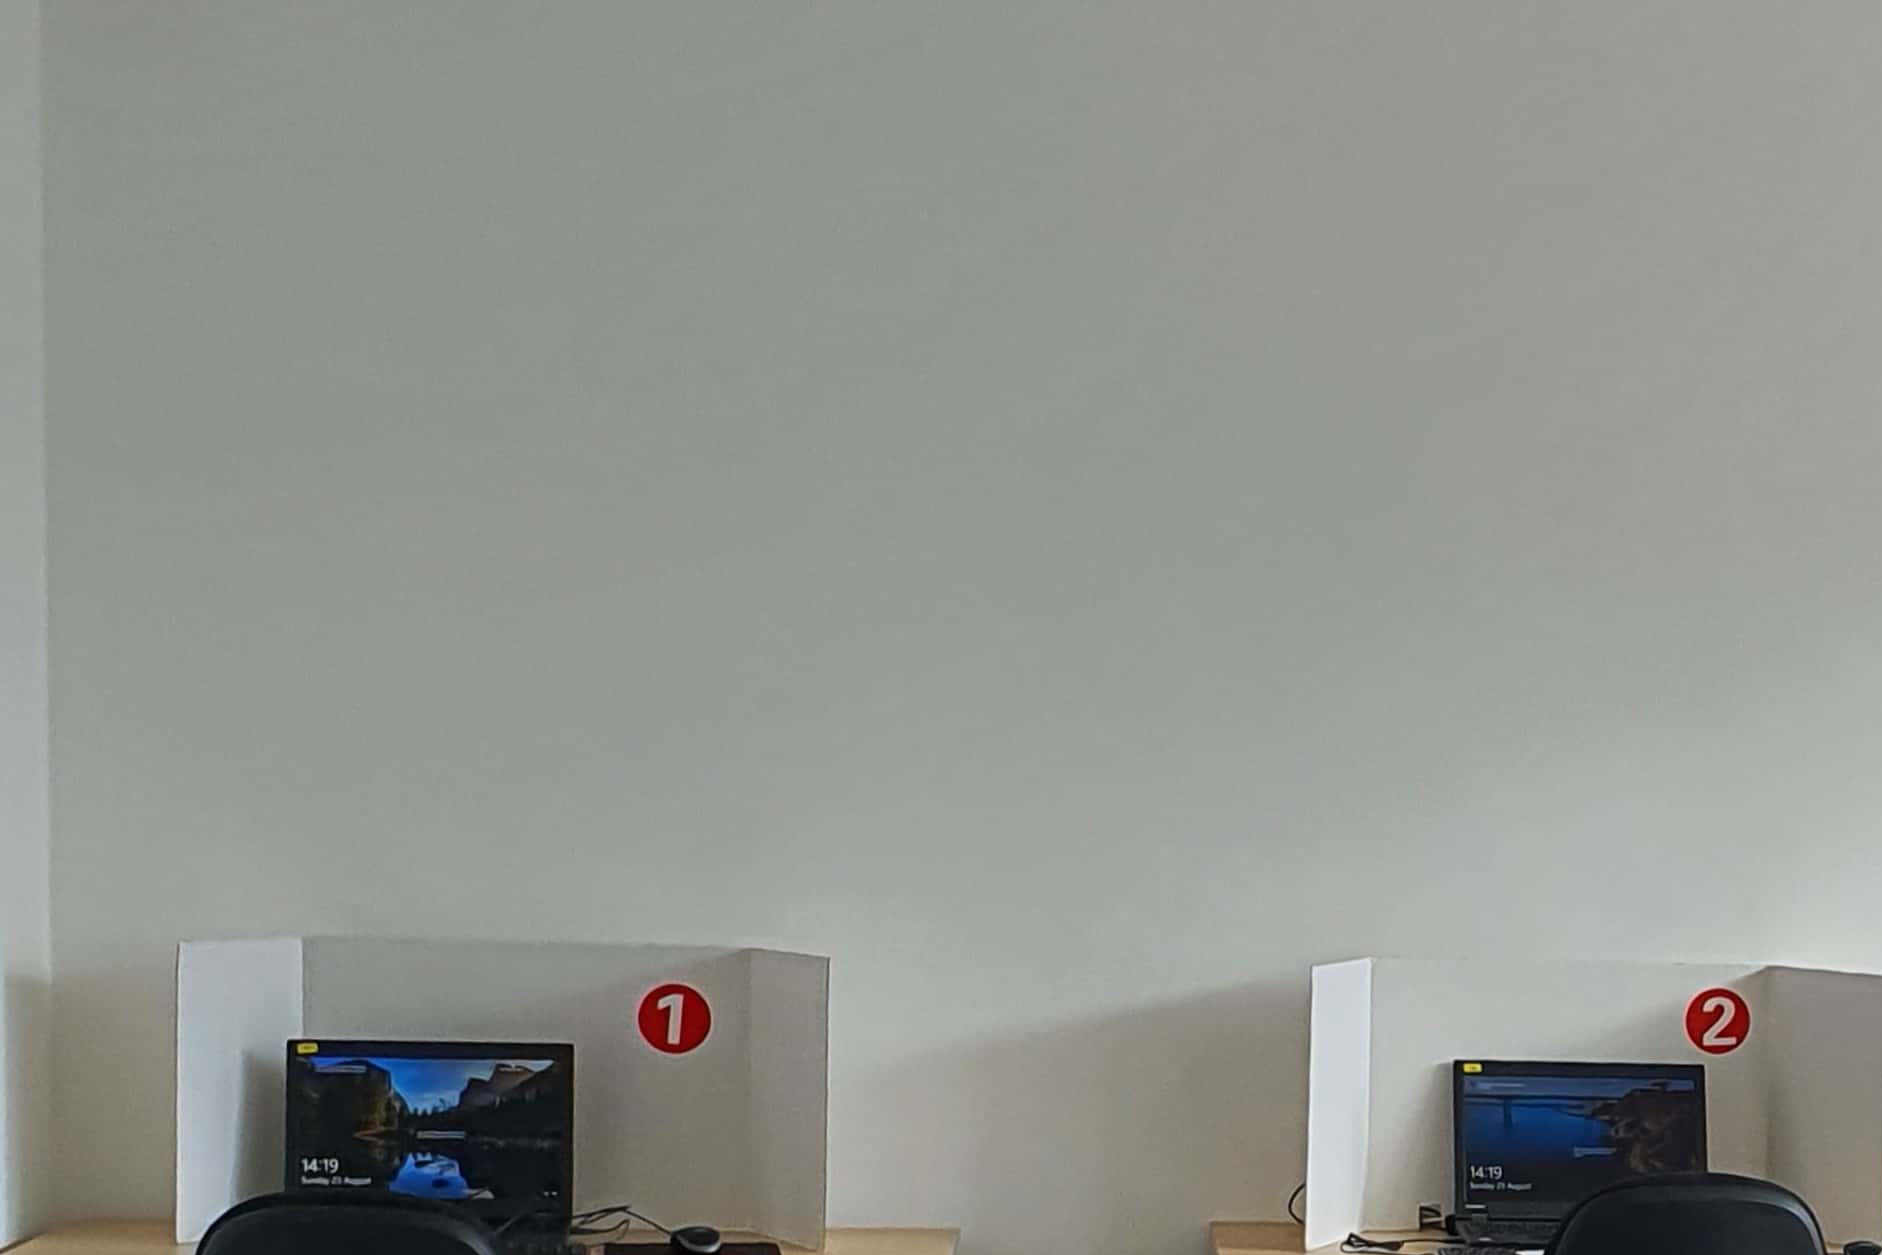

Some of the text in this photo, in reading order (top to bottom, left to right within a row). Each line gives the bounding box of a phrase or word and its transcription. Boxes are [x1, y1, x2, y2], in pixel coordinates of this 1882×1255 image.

[657, 993, 685, 1045] 1
[1702, 996, 1737, 1047] 2
[301, 1158, 339, 1173] 14:19
[1470, 1166, 1502, 1179] 14:19
